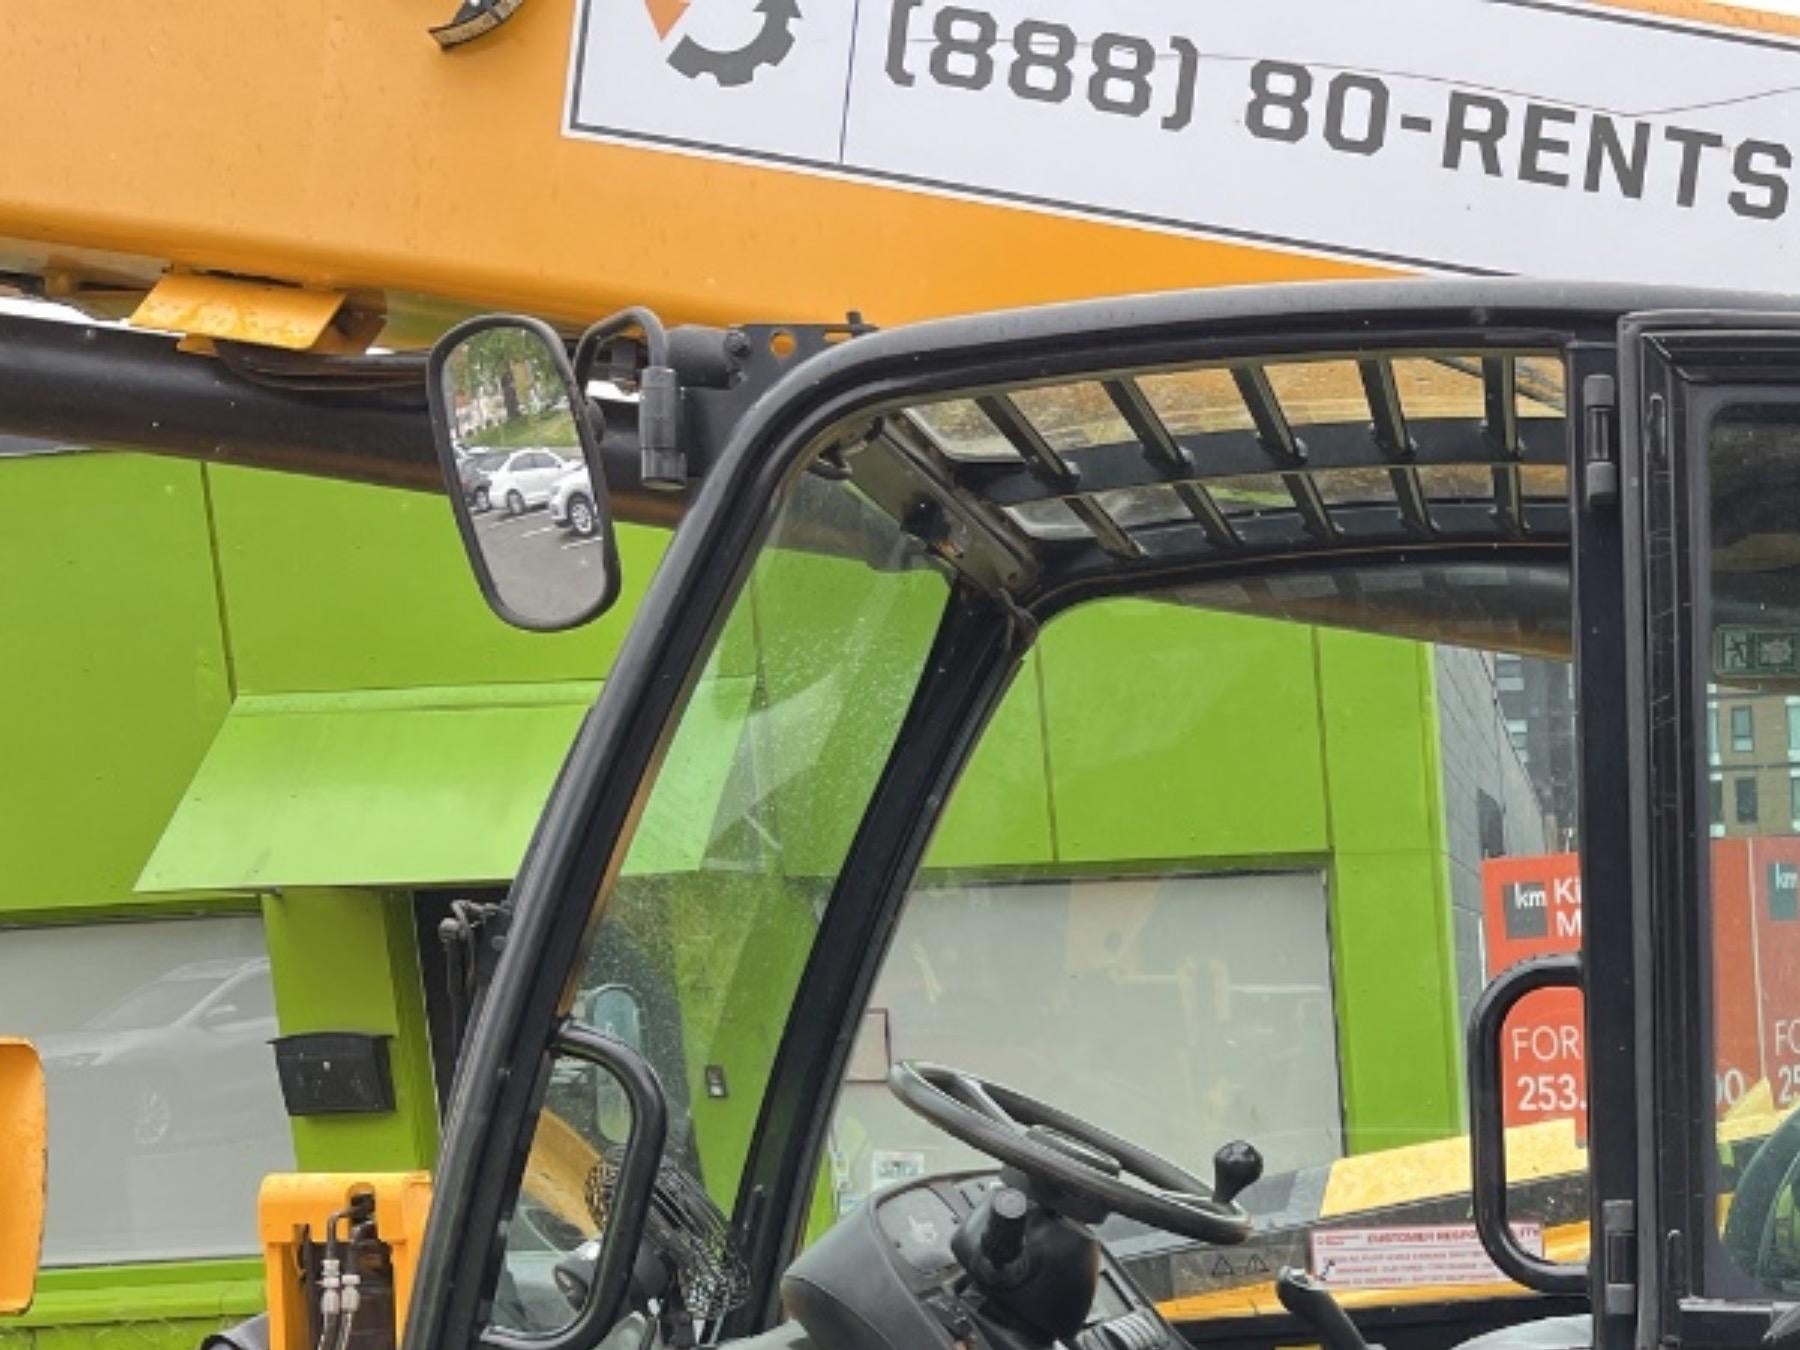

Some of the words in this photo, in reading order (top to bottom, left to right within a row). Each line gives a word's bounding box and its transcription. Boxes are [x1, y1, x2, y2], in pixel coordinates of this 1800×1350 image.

[1244, 58, 1794, 222] 80-RENTS
[1514, 880, 1547, 909] km
[1511, 1024, 1581, 1062] FOR
